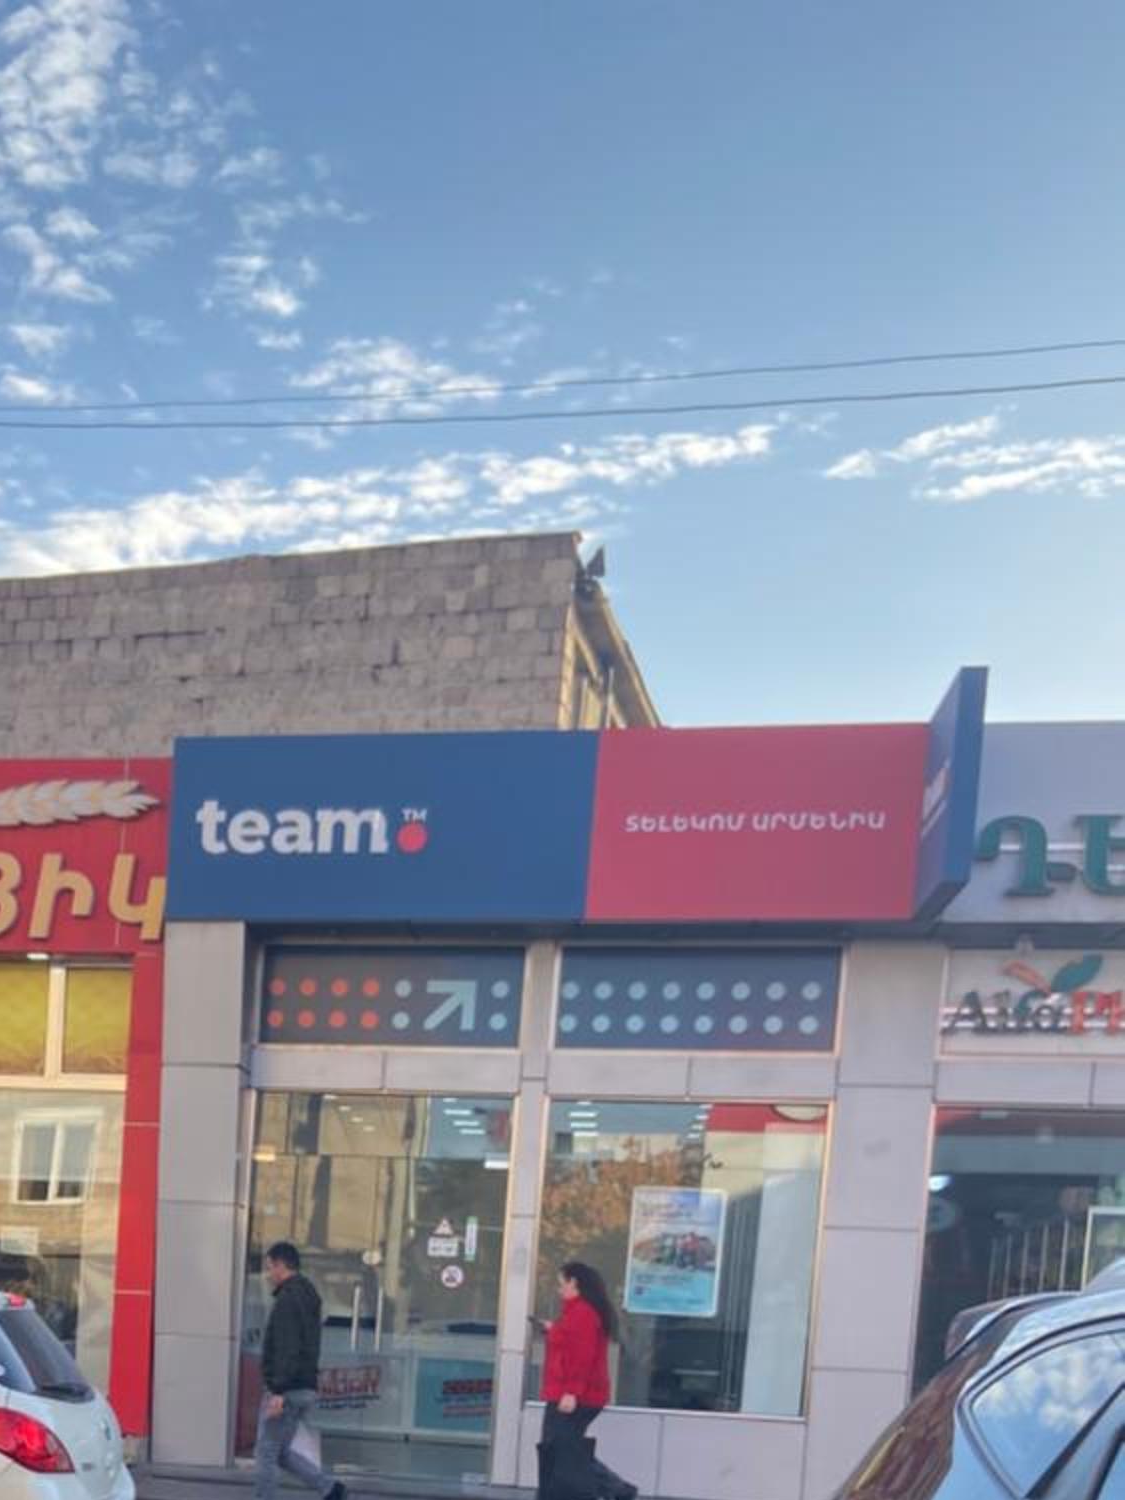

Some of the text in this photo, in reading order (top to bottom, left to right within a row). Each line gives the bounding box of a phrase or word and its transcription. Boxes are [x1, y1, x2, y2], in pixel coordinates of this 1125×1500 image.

[195, 799, 389, 854] team
[625, 810, 887, 833] ՏԵԼԵԿՈՄ ԱՐՄԵՆԻԱ
